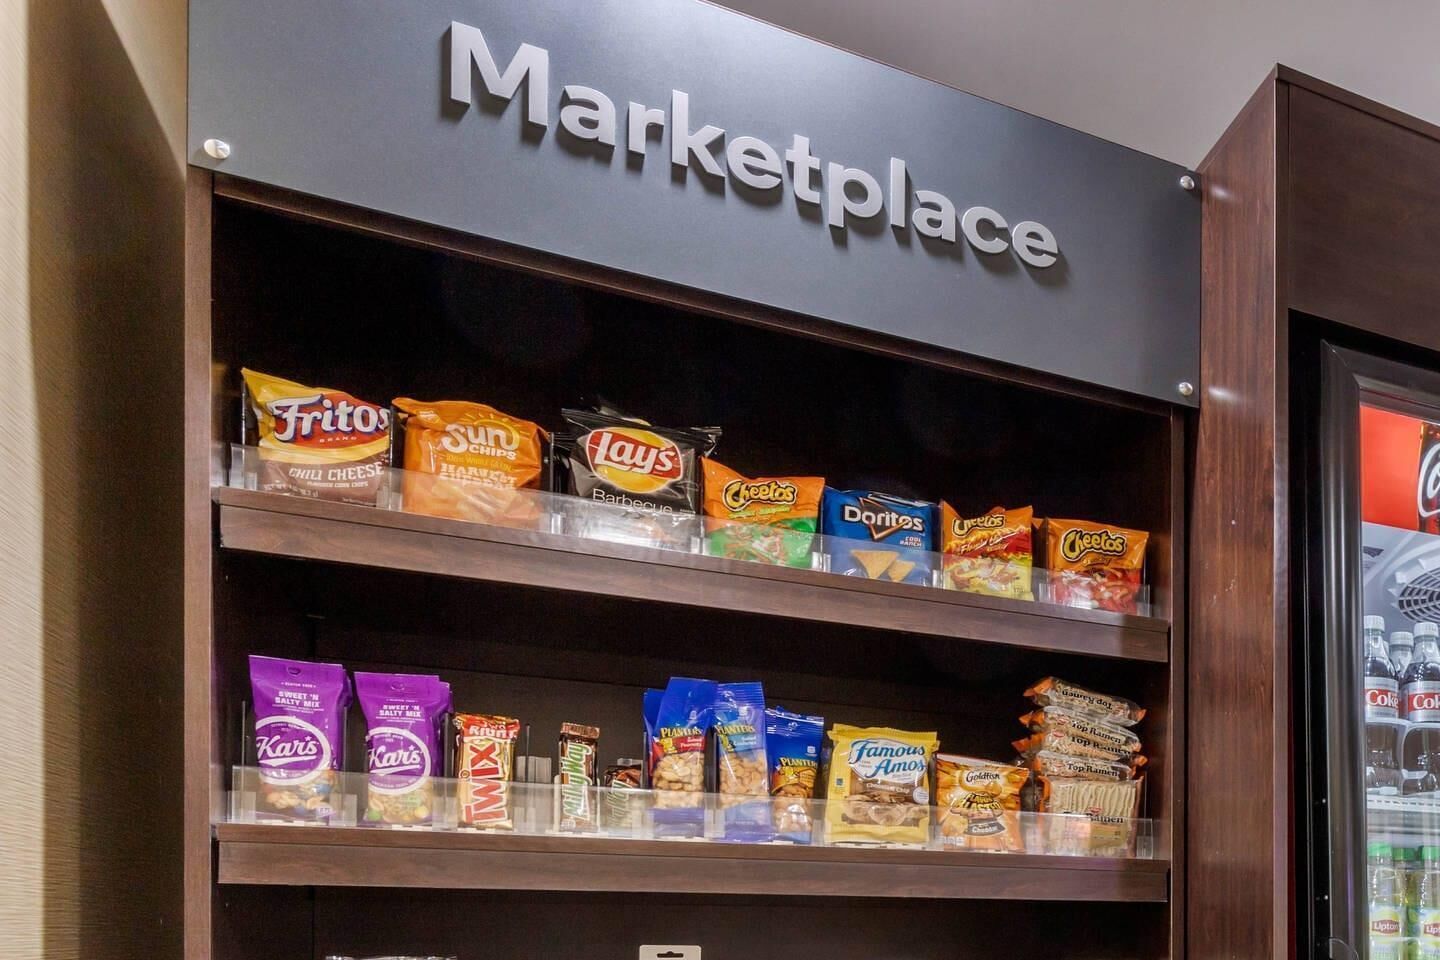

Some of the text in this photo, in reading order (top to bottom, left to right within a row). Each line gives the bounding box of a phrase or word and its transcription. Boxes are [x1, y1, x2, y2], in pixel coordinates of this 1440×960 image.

[449, 20, 1060, 268] Marketplace
[266, 393, 391, 441] Fritos
[441, 422, 520, 454] Sun
[468, 444, 517, 460] CHIPS
[288, 461, 385, 482] CHILI CHEESE
[592, 488, 673, 515] Barbecue
[725, 481, 795, 509] Cheetos
[844, 505, 924, 532] Doritos
[1062, 530, 1126, 561] Cheetos
[275, 697, 301, 706] SALTY
[279, 691, 307, 700] SWEET
[1062, 690, 1113, 711] Top Ramen
[1366, 689, 1399, 706] Coke
[661, 727, 703, 738] PLANTERS
[1071, 720, 1122, 744] Top Ramen
[1071, 737, 1091, 747] Top
[848, 739, 926, 765] Famous
[864, 758, 928, 778] Amos
[965, 771, 1001, 783] Goldfish
[1067, 763, 1118, 777] Top Ramen
[1374, 922, 1400, 933] Lipton
